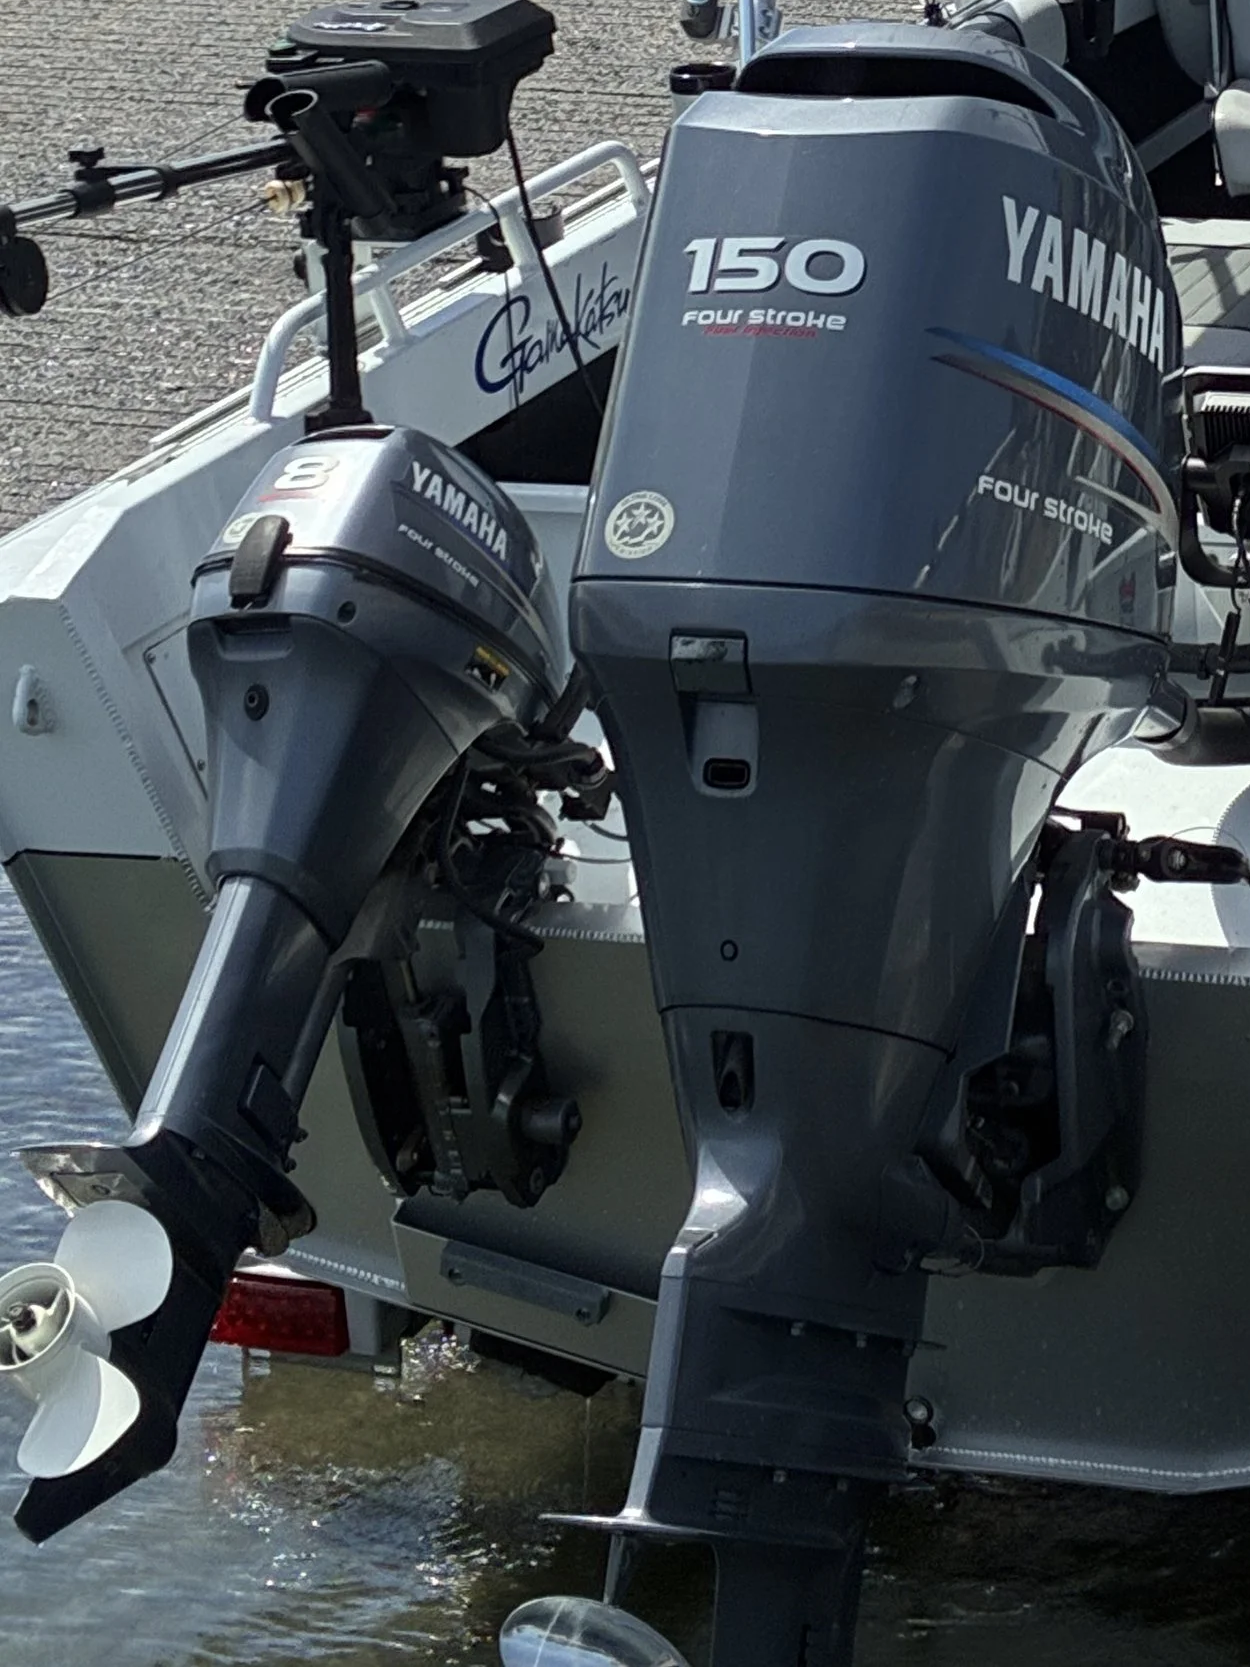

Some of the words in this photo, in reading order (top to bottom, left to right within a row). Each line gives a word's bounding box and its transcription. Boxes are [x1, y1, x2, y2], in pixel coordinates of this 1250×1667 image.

[683, 237, 867, 297] 150
[1003, 195, 1165, 373] YAMAHA
[274, 455, 340, 490] 8
[411, 461, 508, 561] YAMAHA
